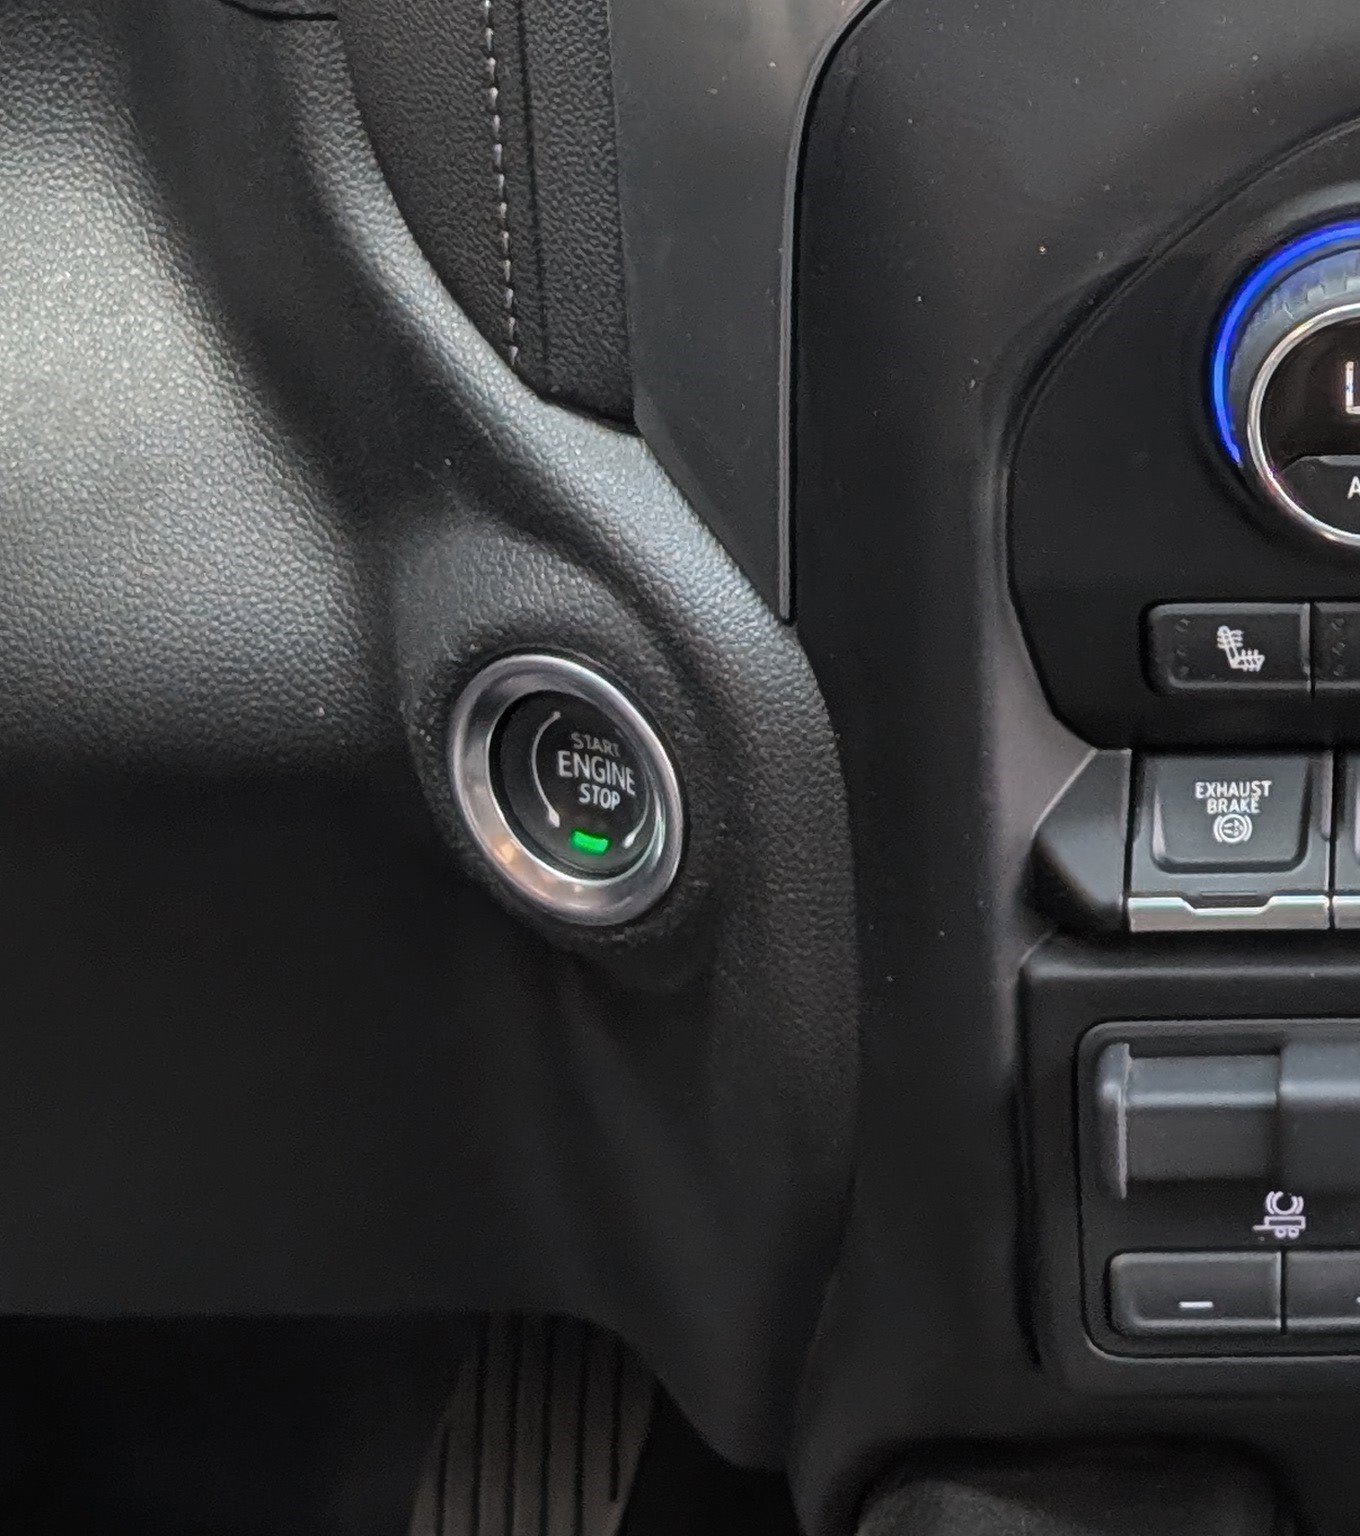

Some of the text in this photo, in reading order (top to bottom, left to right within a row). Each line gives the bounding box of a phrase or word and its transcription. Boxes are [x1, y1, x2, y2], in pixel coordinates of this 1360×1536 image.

[571, 731, 621, 758] START
[557, 749, 636, 797] ENGINE
[578, 783, 622, 811] STOP
[1194, 780, 1272, 799] EXHAUST
[1206, 797, 1260, 815] BRAKE
